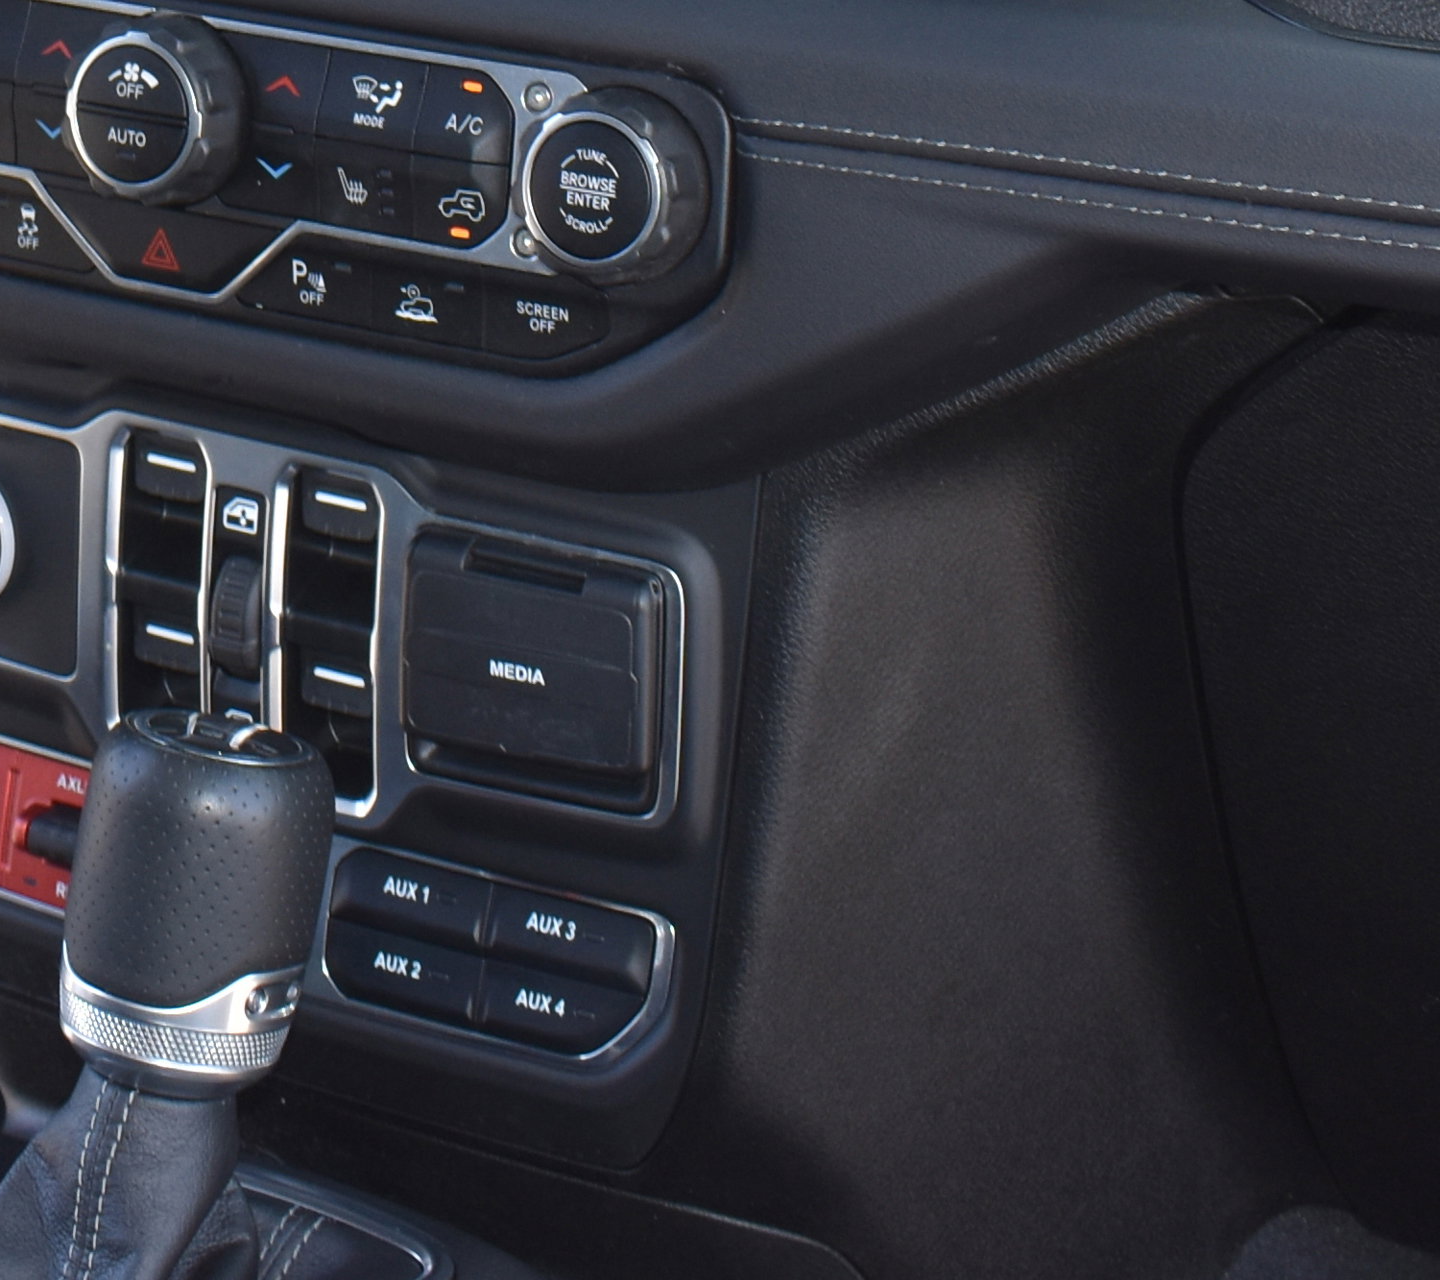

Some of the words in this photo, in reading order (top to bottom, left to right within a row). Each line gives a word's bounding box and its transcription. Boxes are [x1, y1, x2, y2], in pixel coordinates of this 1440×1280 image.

[116, 82, 144, 100] OFF
[353, 113, 385, 130] MODE
[445, 114, 484, 136] A/C
[107, 129, 146, 148] AUTO
[576, 148, 607, 165] TUNE
[560, 170, 617, 193] BROWSE
[566, 191, 610, 213] ENTER
[564, 212, 608, 234] SCROLL
[18, 235, 40, 251] OFF
[299, 290, 325, 306] OFF
[516, 301, 570, 324] SCREEN
[528, 318, 556, 335] OFF
[488, 661, 546, 687] MEDIA
[56, 773, 87, 795] AXL
[383, 875, 418, 902] AUX
[422, 886, 430, 904] 1
[526, 911, 563, 938] AUX
[565, 920, 576, 940] 3
[374, 951, 408, 976] AUX
[410, 961, 421, 980] 2
[515, 988, 552, 1014] AUX
[554, 999, 565, 1017] 4
